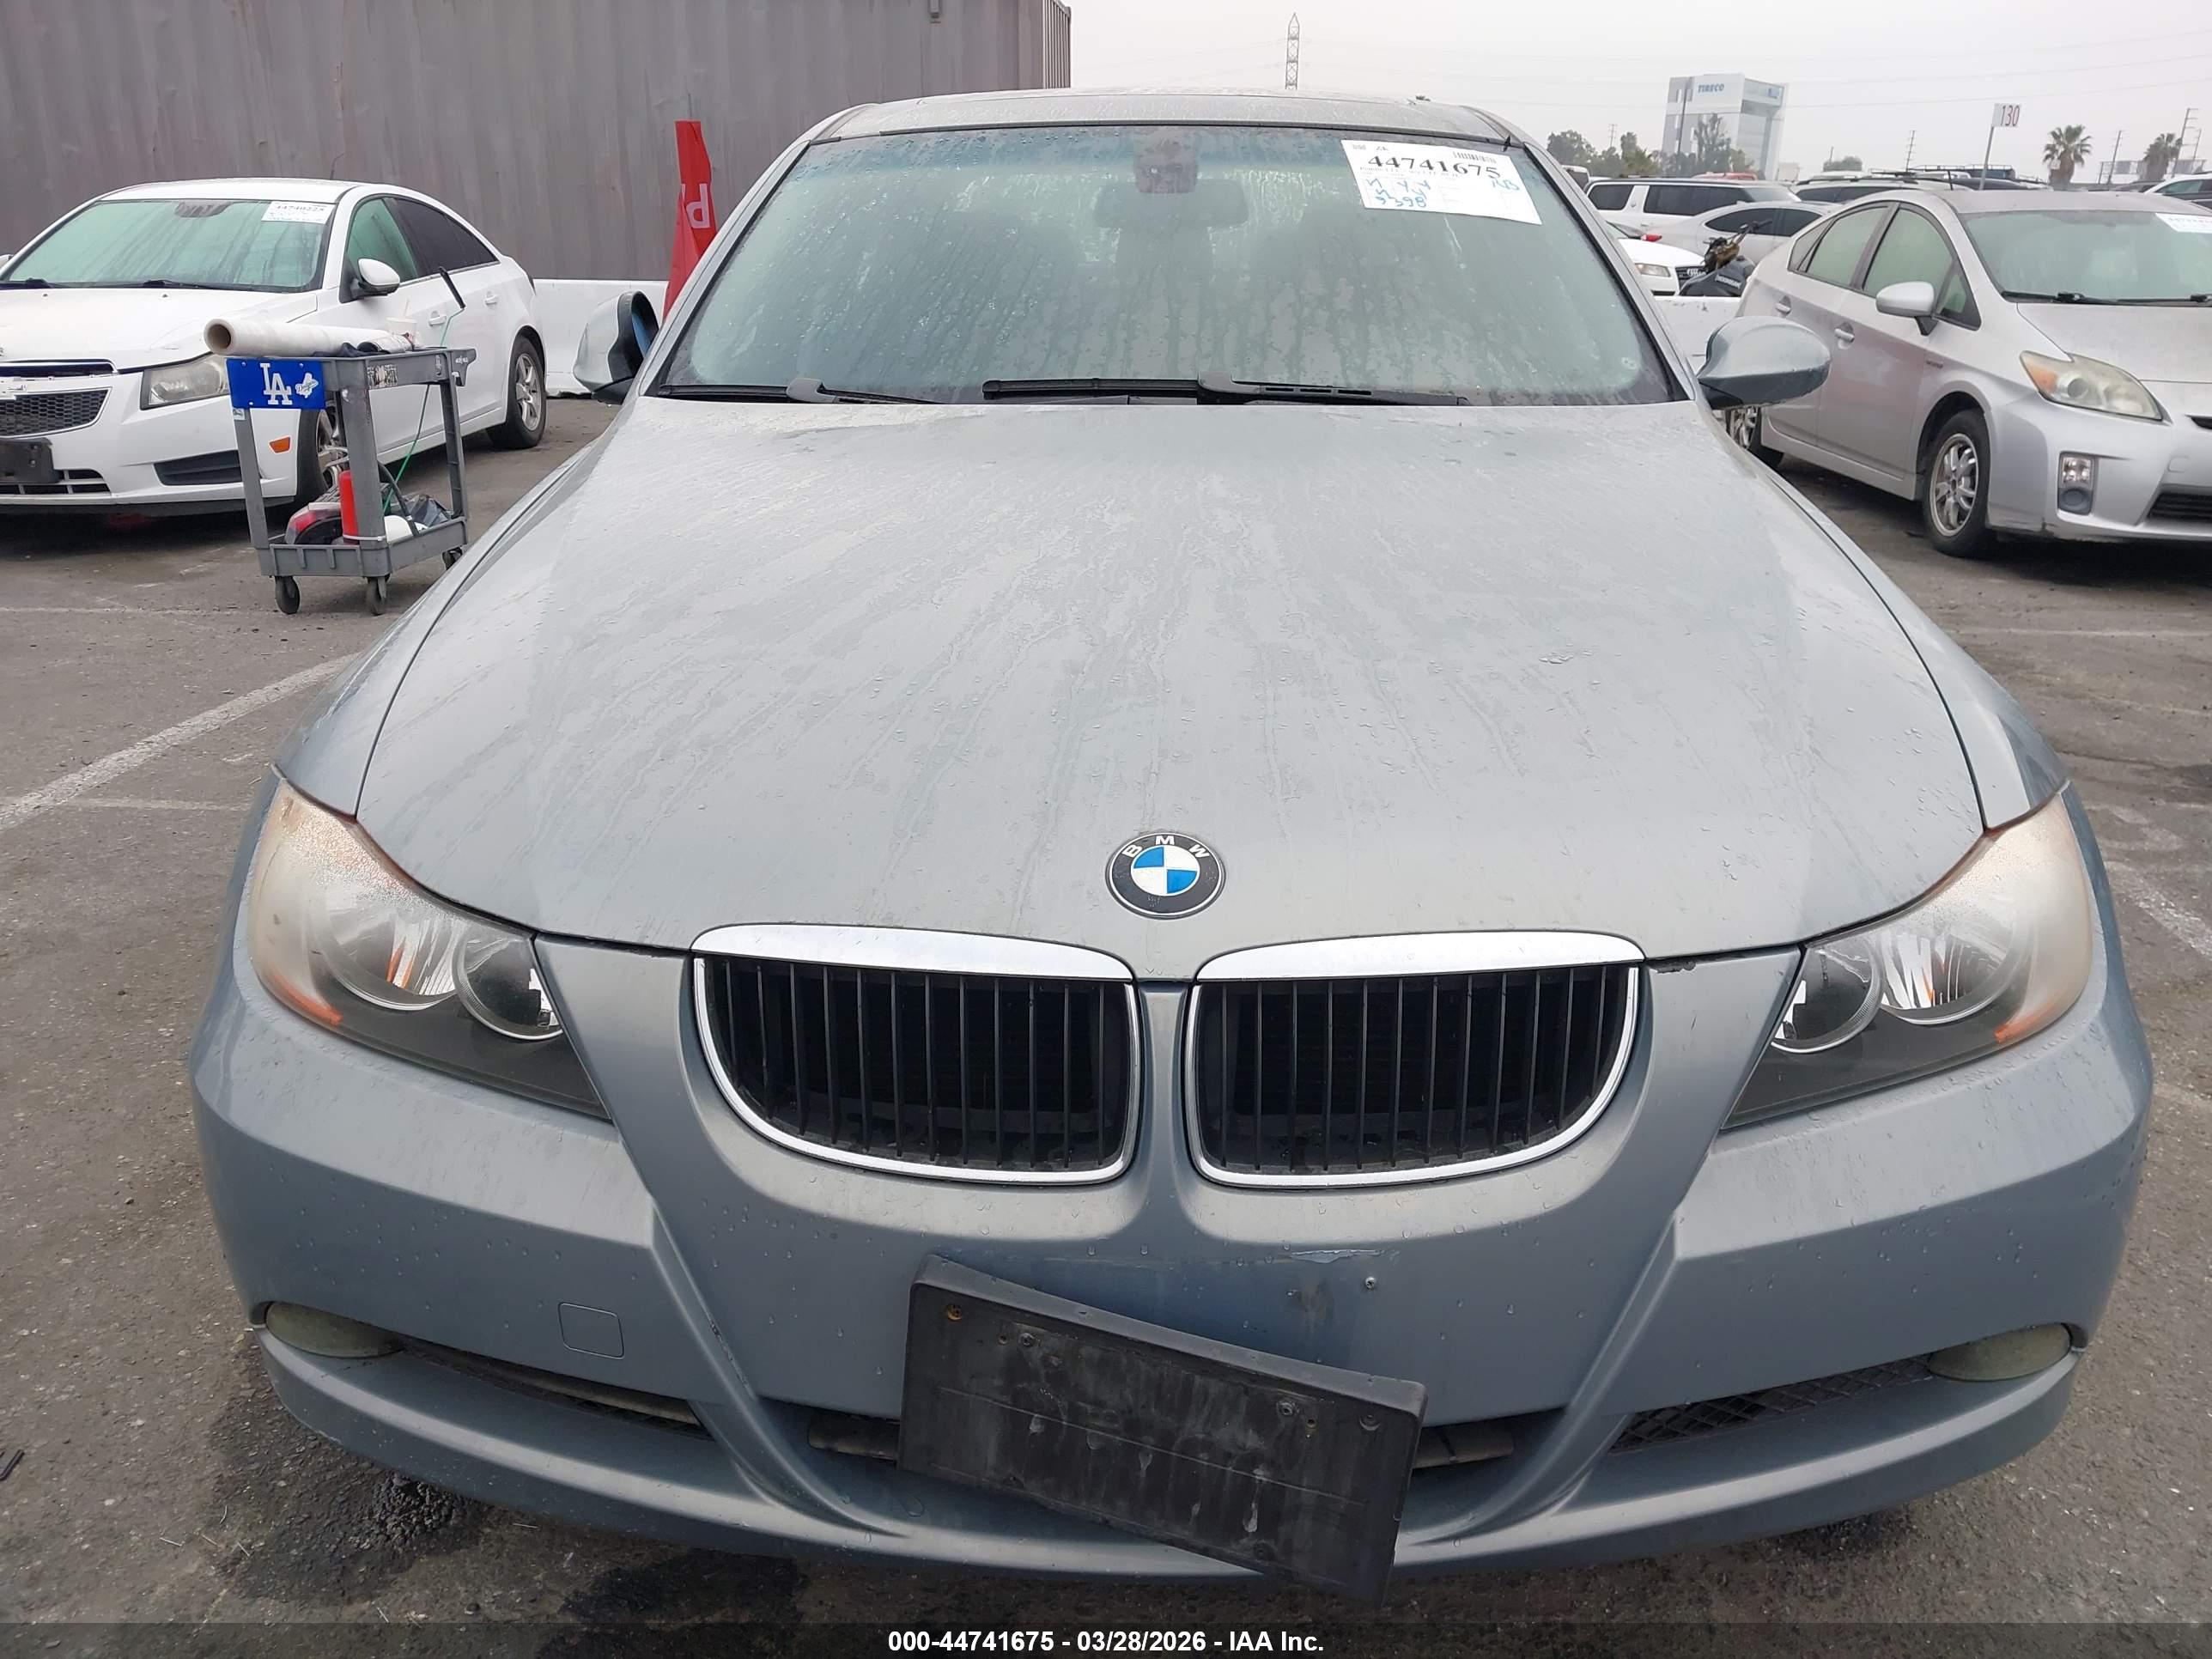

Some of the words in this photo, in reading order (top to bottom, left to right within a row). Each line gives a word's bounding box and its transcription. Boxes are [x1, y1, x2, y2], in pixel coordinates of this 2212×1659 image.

[2001, 105, 2020, 127] 130
[1368, 155, 1500, 179] 44741675
[259, 362, 293, 405] LA
[1121, 835, 1210, 858] BMW
